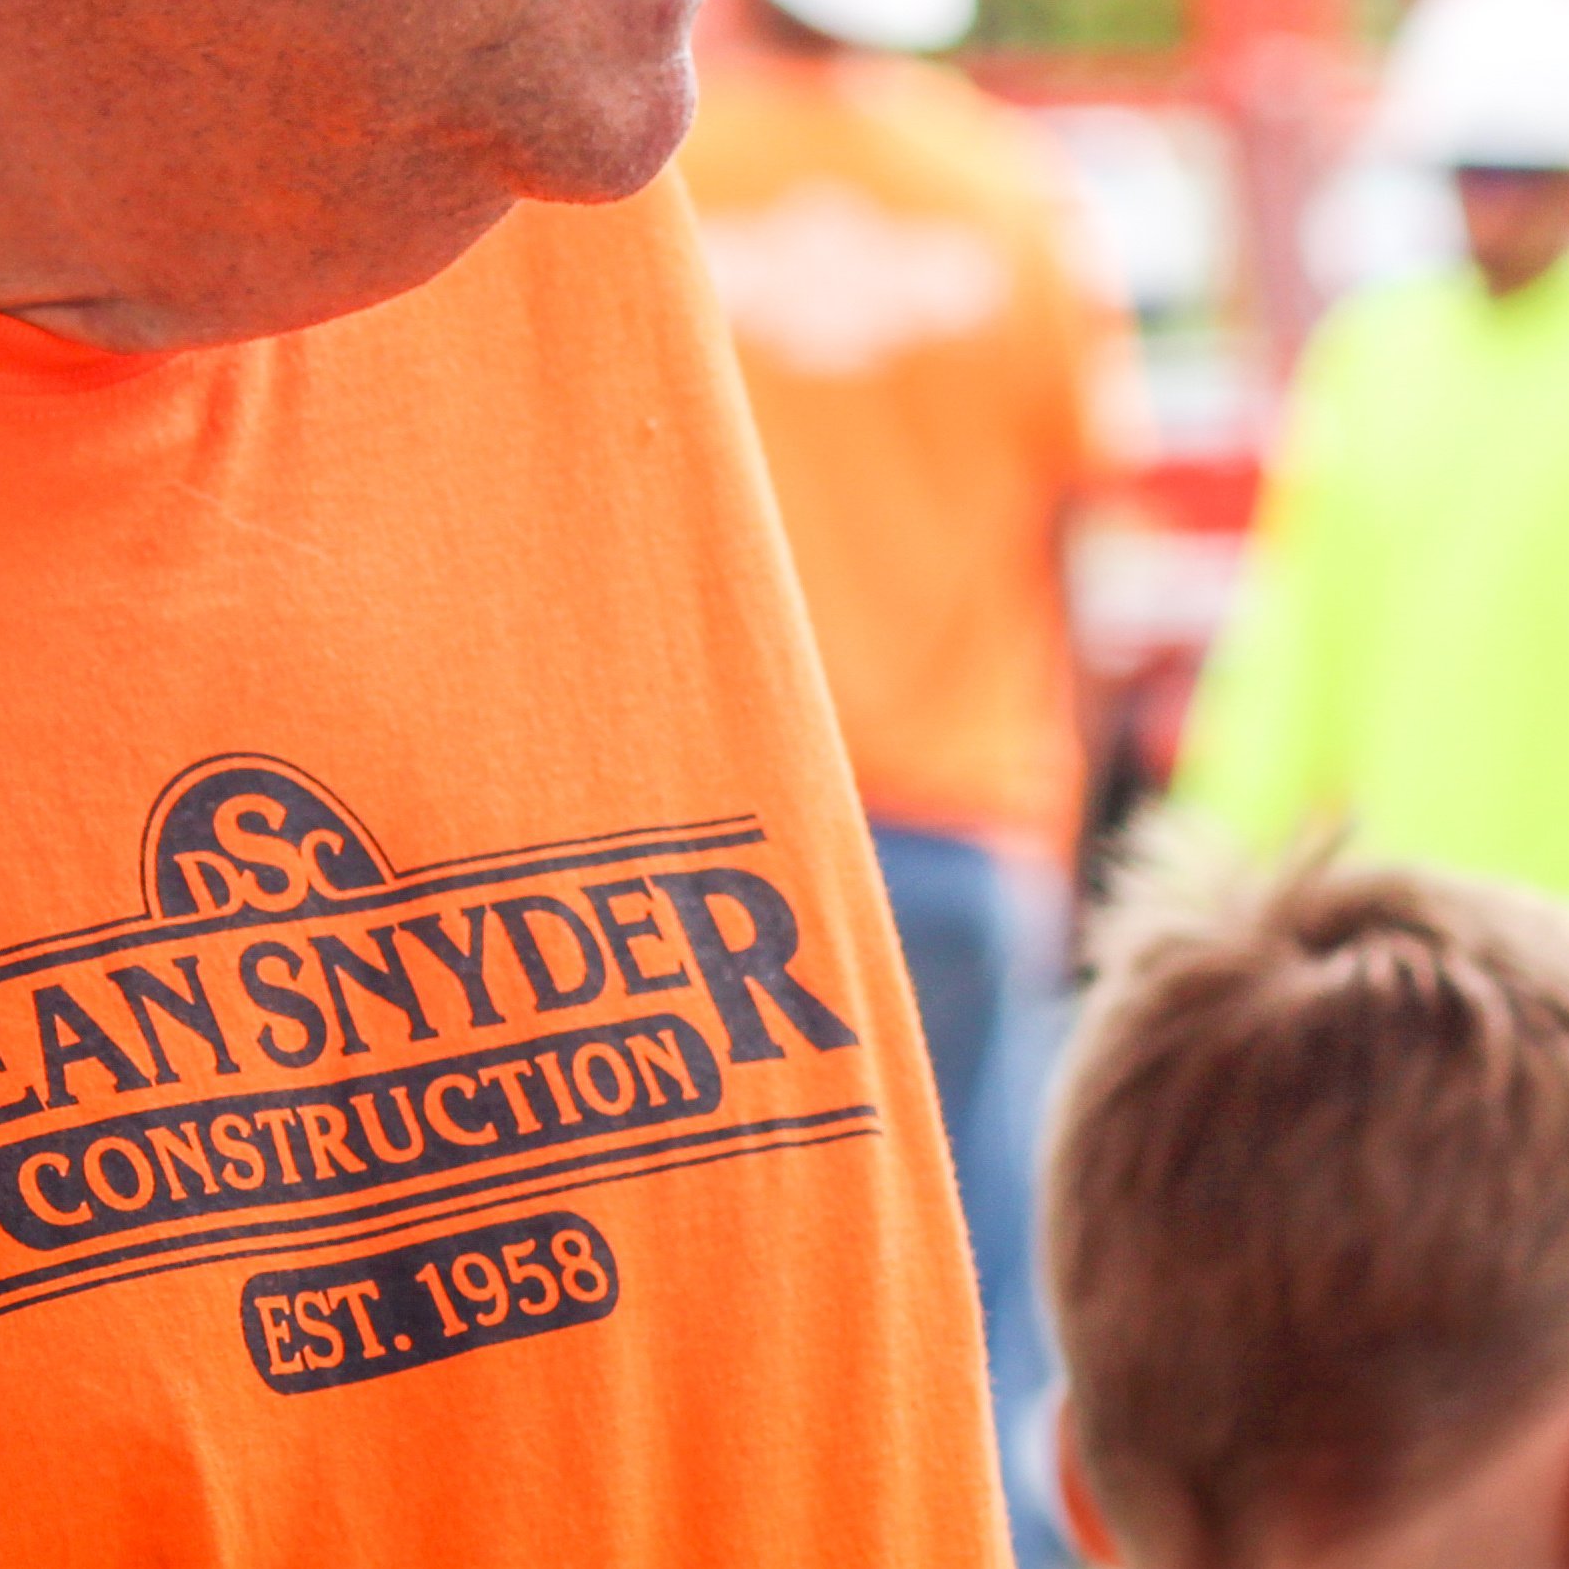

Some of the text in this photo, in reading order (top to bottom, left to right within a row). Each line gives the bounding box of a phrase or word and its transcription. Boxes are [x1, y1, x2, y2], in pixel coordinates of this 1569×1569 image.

[173, 792, 345, 913] DSC
[230, 867, 860, 1064] SNYDER
[17, 1028, 701, 1227] CONSTRUCTION
[254, 1228, 610, 1376] EST. 1958
